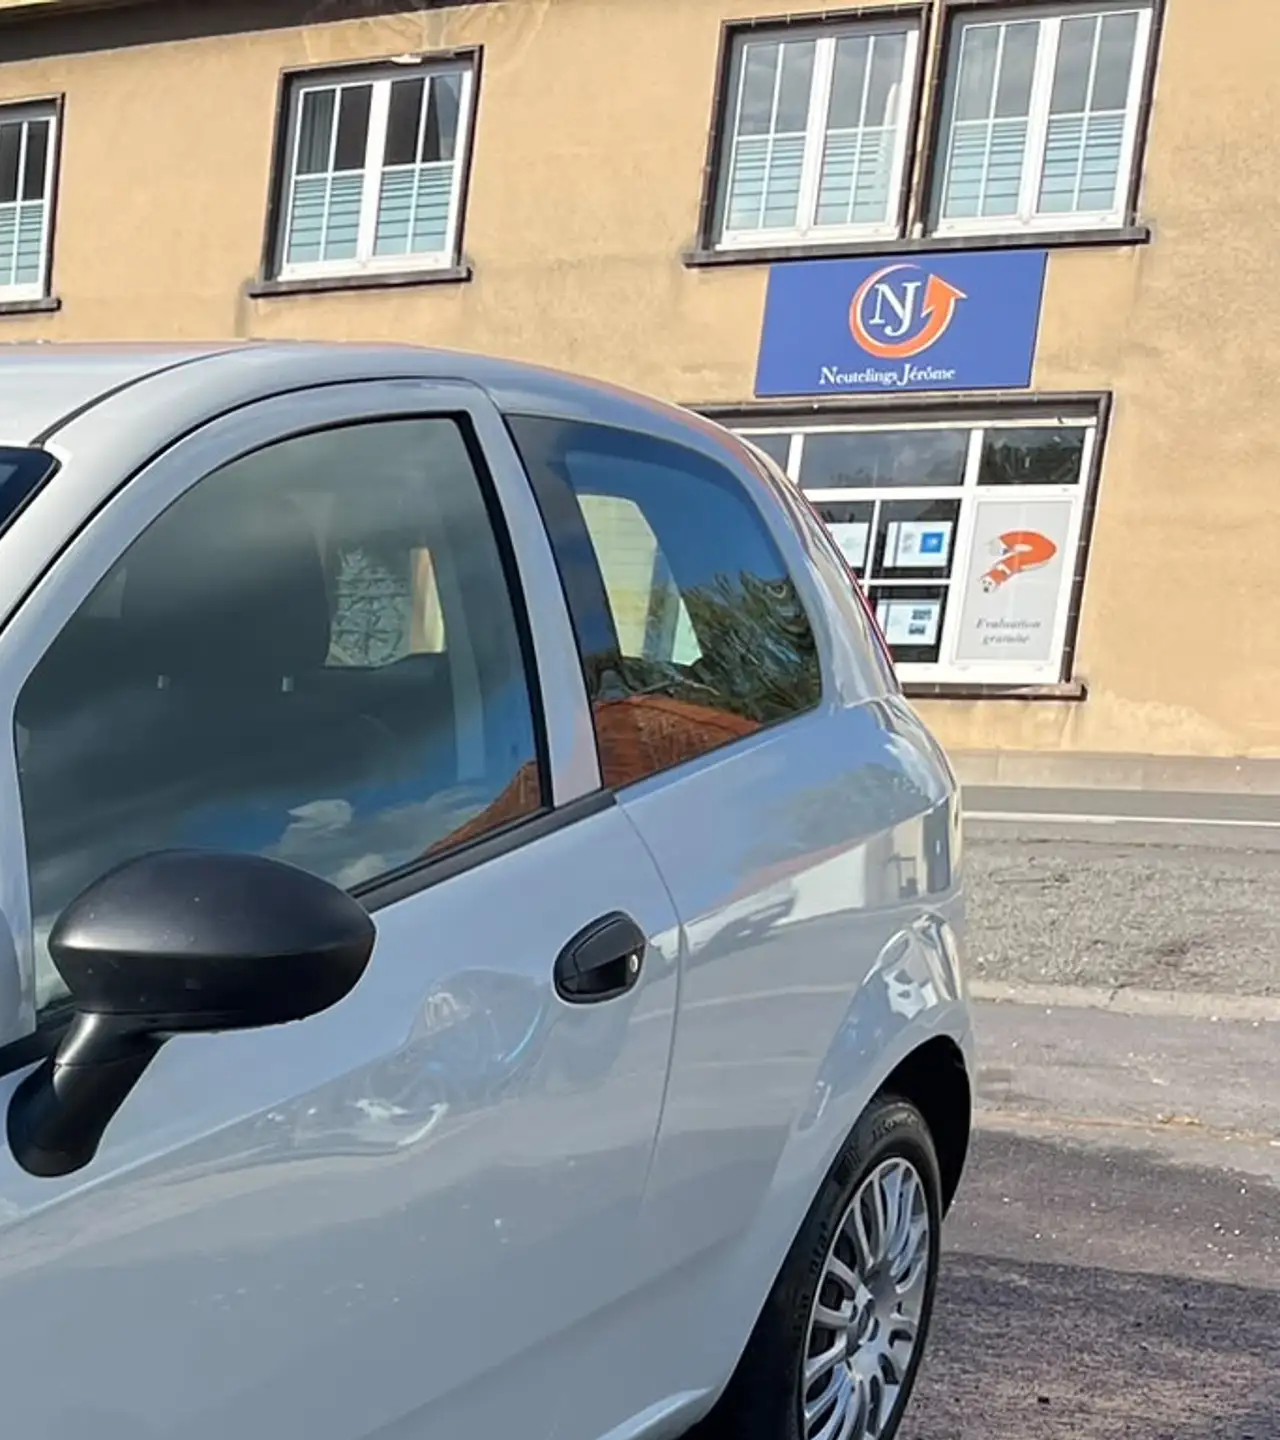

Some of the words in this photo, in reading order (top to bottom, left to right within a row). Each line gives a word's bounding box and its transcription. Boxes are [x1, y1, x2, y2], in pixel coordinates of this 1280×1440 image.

[868, 281, 921, 337] NJ
[819, 365, 897, 386] Neutelings
[897, 362, 956, 386] Jérôme
